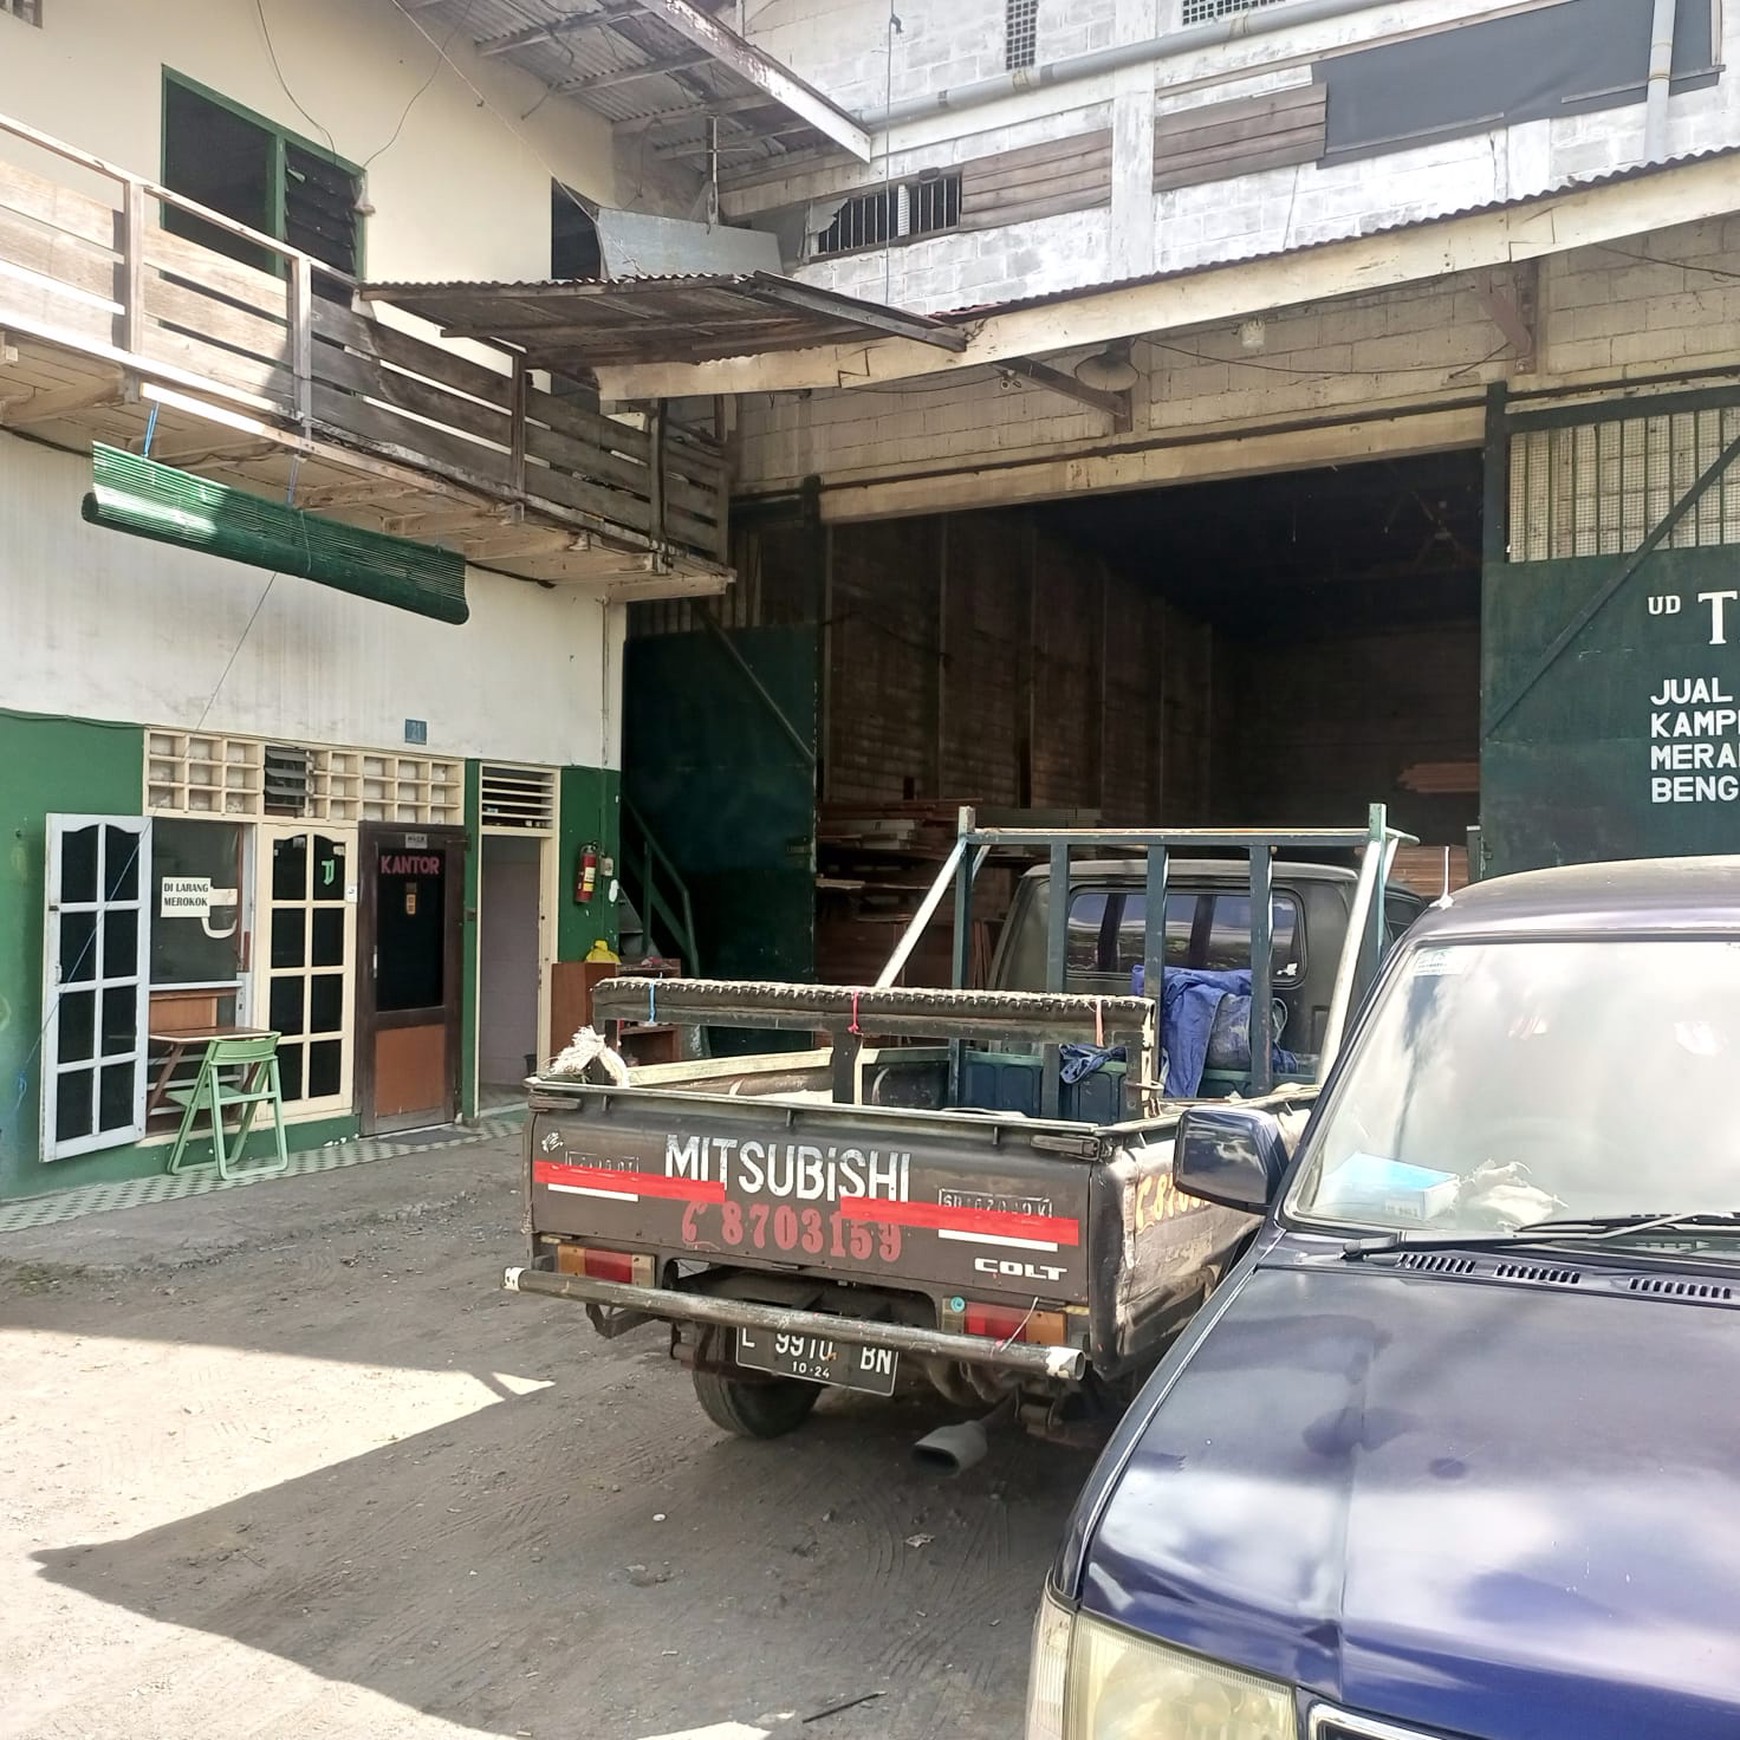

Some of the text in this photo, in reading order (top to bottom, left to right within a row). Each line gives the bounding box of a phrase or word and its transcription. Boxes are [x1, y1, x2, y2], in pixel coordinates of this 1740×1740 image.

[1647, 594, 1682, 615] UD
[1650, 676, 1734, 706] JUAL
[1651, 709, 1740, 738] KAMP
[1651, 742, 1740, 771] MERA
[1651, 775, 1739, 804] BENG
[381, 855, 440, 875] KANTOR
[164, 883, 209, 893] DI LARANG
[164, 897, 208, 906] MEROKOK
[721, 1201, 902, 1263] 8703159
[974, 1257, 1068, 1281] COLT
[860, 1346, 892, 1375] BN
